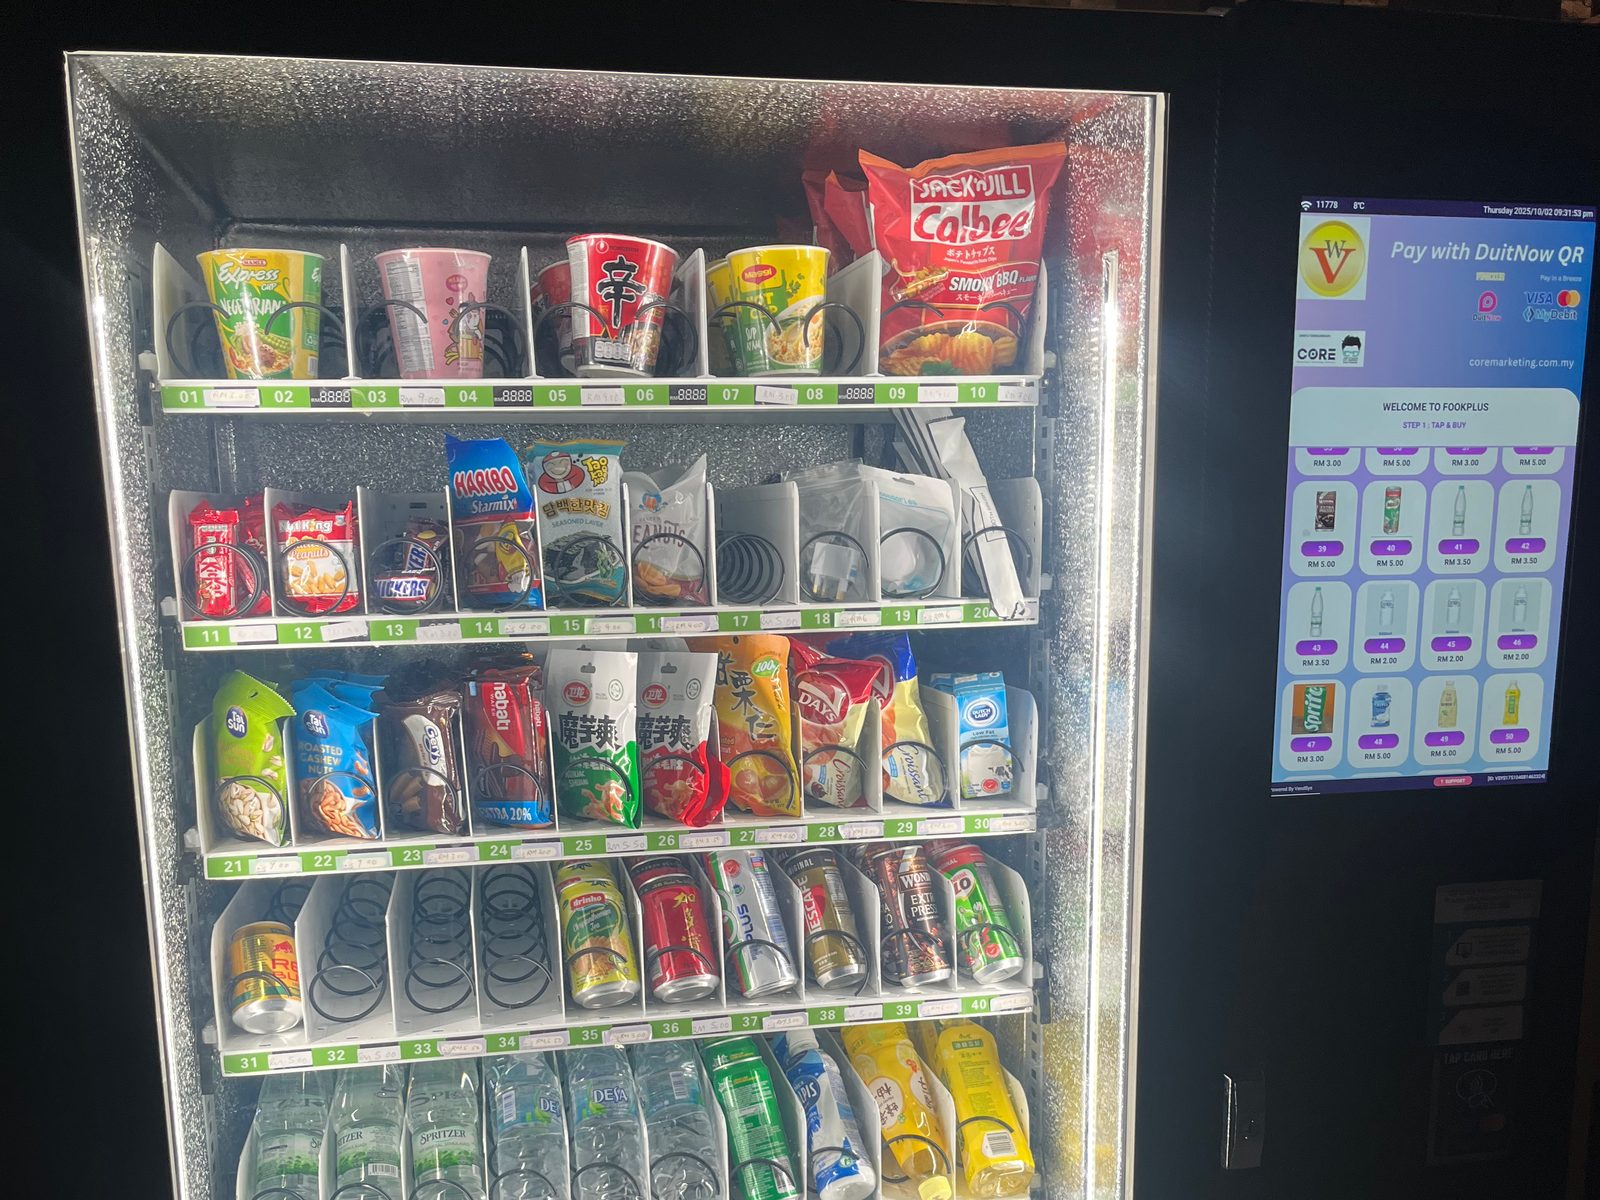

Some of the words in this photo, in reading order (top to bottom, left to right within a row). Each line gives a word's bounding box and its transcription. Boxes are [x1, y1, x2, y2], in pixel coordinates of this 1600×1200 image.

[1316, 200, 1338, 209] 11778
[1483, 206, 1513, 216] Thursday
[1514, 206, 1553, 216] 2025/10/02
[1554, 208, 1581, 217] 09:31:53
[1582, 210, 1594, 218] pm
[913, 204, 1031, 243] Calbee
[1392, 241, 1426, 263] Pay
[1431, 243, 1470, 260] with
[1474, 243, 1553, 263] DuitNow
[1557, 246, 1584, 266] QR
[218, 262, 280, 289] Express
[949, 273, 995, 292] SMOKY
[997, 270, 1018, 287] BBQ
[596, 255, 648, 329] 辛
[1527, 292, 1553, 304] VISA
[1297, 348, 1336, 361] CORE
[1469, 357, 1574, 370] coremarketing.com.my
[179, 391, 198, 403] 01
[274, 391, 294, 403] 02
[368, 391, 387, 403] 03
[459, 391, 478, 402] 04
[549, 390, 567, 402] 05
[636, 389, 654, 401] 06
[722, 389, 739, 400] 07
[806, 389, 823, 400] 08
[889, 387, 905, 399] 09
[970, 387, 986, 398] 10
[1382, 402, 1426, 412] WELCOME
[1429, 402, 1441, 412] TO
[1442, 402, 1489, 412] FOOKPLUS
[1403, 421, 1420, 429] STEP
[1431, 421, 1445, 429] TAP
[1452, 421, 1467, 429] BUY
[1326, 459, 1341, 467] 3.00
[1383, 459, 1395, 467] RM
[1395, 459, 1411, 467] 5.00
[1451, 459, 1463, 467] RM
[1464, 459, 1479, 467] 3.00
[1531, 458, 1546, 466] 5.00
[453, 466, 518, 497] HARIBO
[471, 496, 515, 514] Starmix
[1317, 545, 1327, 553] 39
[1387, 544, 1395, 552] 40
[1454, 543, 1463, 551] 41
[1521, 542, 1530, 550] 42
[1308, 560, 1320, 568] RM
[1320, 560, 1336, 568] 5.00
[1376, 559, 1388, 567] RM
[1389, 559, 1404, 567] 5.00
[1444, 558, 1456, 566] RM
[1457, 558, 1471, 566] 3.50
[1511, 557, 1523, 565] RM
[1523, 557, 1538, 565] 3.50
[895, 610, 911, 622] 19
[974, 607, 989, 619] 20
[733, 615, 749, 627] 17
[814, 613, 831, 625] 18
[386, 624, 404, 636] 13
[475, 621, 493, 633] 14
[563, 620, 581, 631] 15
[202, 630, 219, 642] 11
[294, 627, 313, 639] 12
[1380, 642, 1389, 650] 44
[1447, 640, 1456, 648] 45
[1513, 638, 1522, 646] 46
[1312, 644, 1322, 652] 43
[1302, 659, 1314, 667] RM
[1315, 658, 1330, 667] 3.50
[1370, 657, 1382, 665] RM
[1383, 656, 1398, 664] 2.00
[1437, 655, 1449, 663] RM
[1449, 655, 1464, 663] 2.00
[1503, 653, 1515, 661] RM
[1515, 653, 1529, 661] 2.00
[494, 682, 511, 731] nabati
[799, 692, 837, 722] DAYS
[972, 708, 991, 716] DUTCH
[1304, 685, 1326, 733] Sprite
[231, 710, 245, 724] Tai
[309, 714, 325, 727] Tai
[228, 719, 246, 734] Sun
[306, 721, 327, 736] Sun
[558, 711, 624, 752] 魔芋爽
[1440, 735, 1449, 743] 49
[1505, 732, 1514, 740] 50
[1307, 740, 1316, 748] 47
[1374, 738, 1383, 746] 48
[1376, 752, 1391, 760] 5.00
[1442, 749, 1457, 757] 5.00
[1297, 755, 1309, 763] RM
[1309, 755, 1325, 763] 3.00
[510, 807, 532, 820] 20%
[897, 822, 913, 833] 29
[974, 818, 990, 829] 30
[740, 831, 754, 842] 27
[819, 827, 835, 838] 28
[576, 840, 592, 851] 25
[659, 835, 675, 846] 26
[490, 844, 508, 856] 24
[314, 855, 333, 867] 22
[403, 850, 421, 862] 23
[224, 860, 242, 873] 21
[573, 895, 602, 907] drinho
[971, 999, 987, 1009] 40
[820, 1010, 836, 1021] 38
[896, 1005, 912, 1015] 39
[742, 1016, 758, 1027] 37
[662, 1022, 679, 1033] 36
[582, 1029, 598, 1041] 35
[498, 1036, 516, 1047] 34
[414, 1043, 432, 1054] 33
[327, 1050, 346, 1061] 32
[240, 1057, 257, 1068] 31
[593, 1086, 629, 1104] DESA
[420, 1129, 466, 1145] SPRITZER
